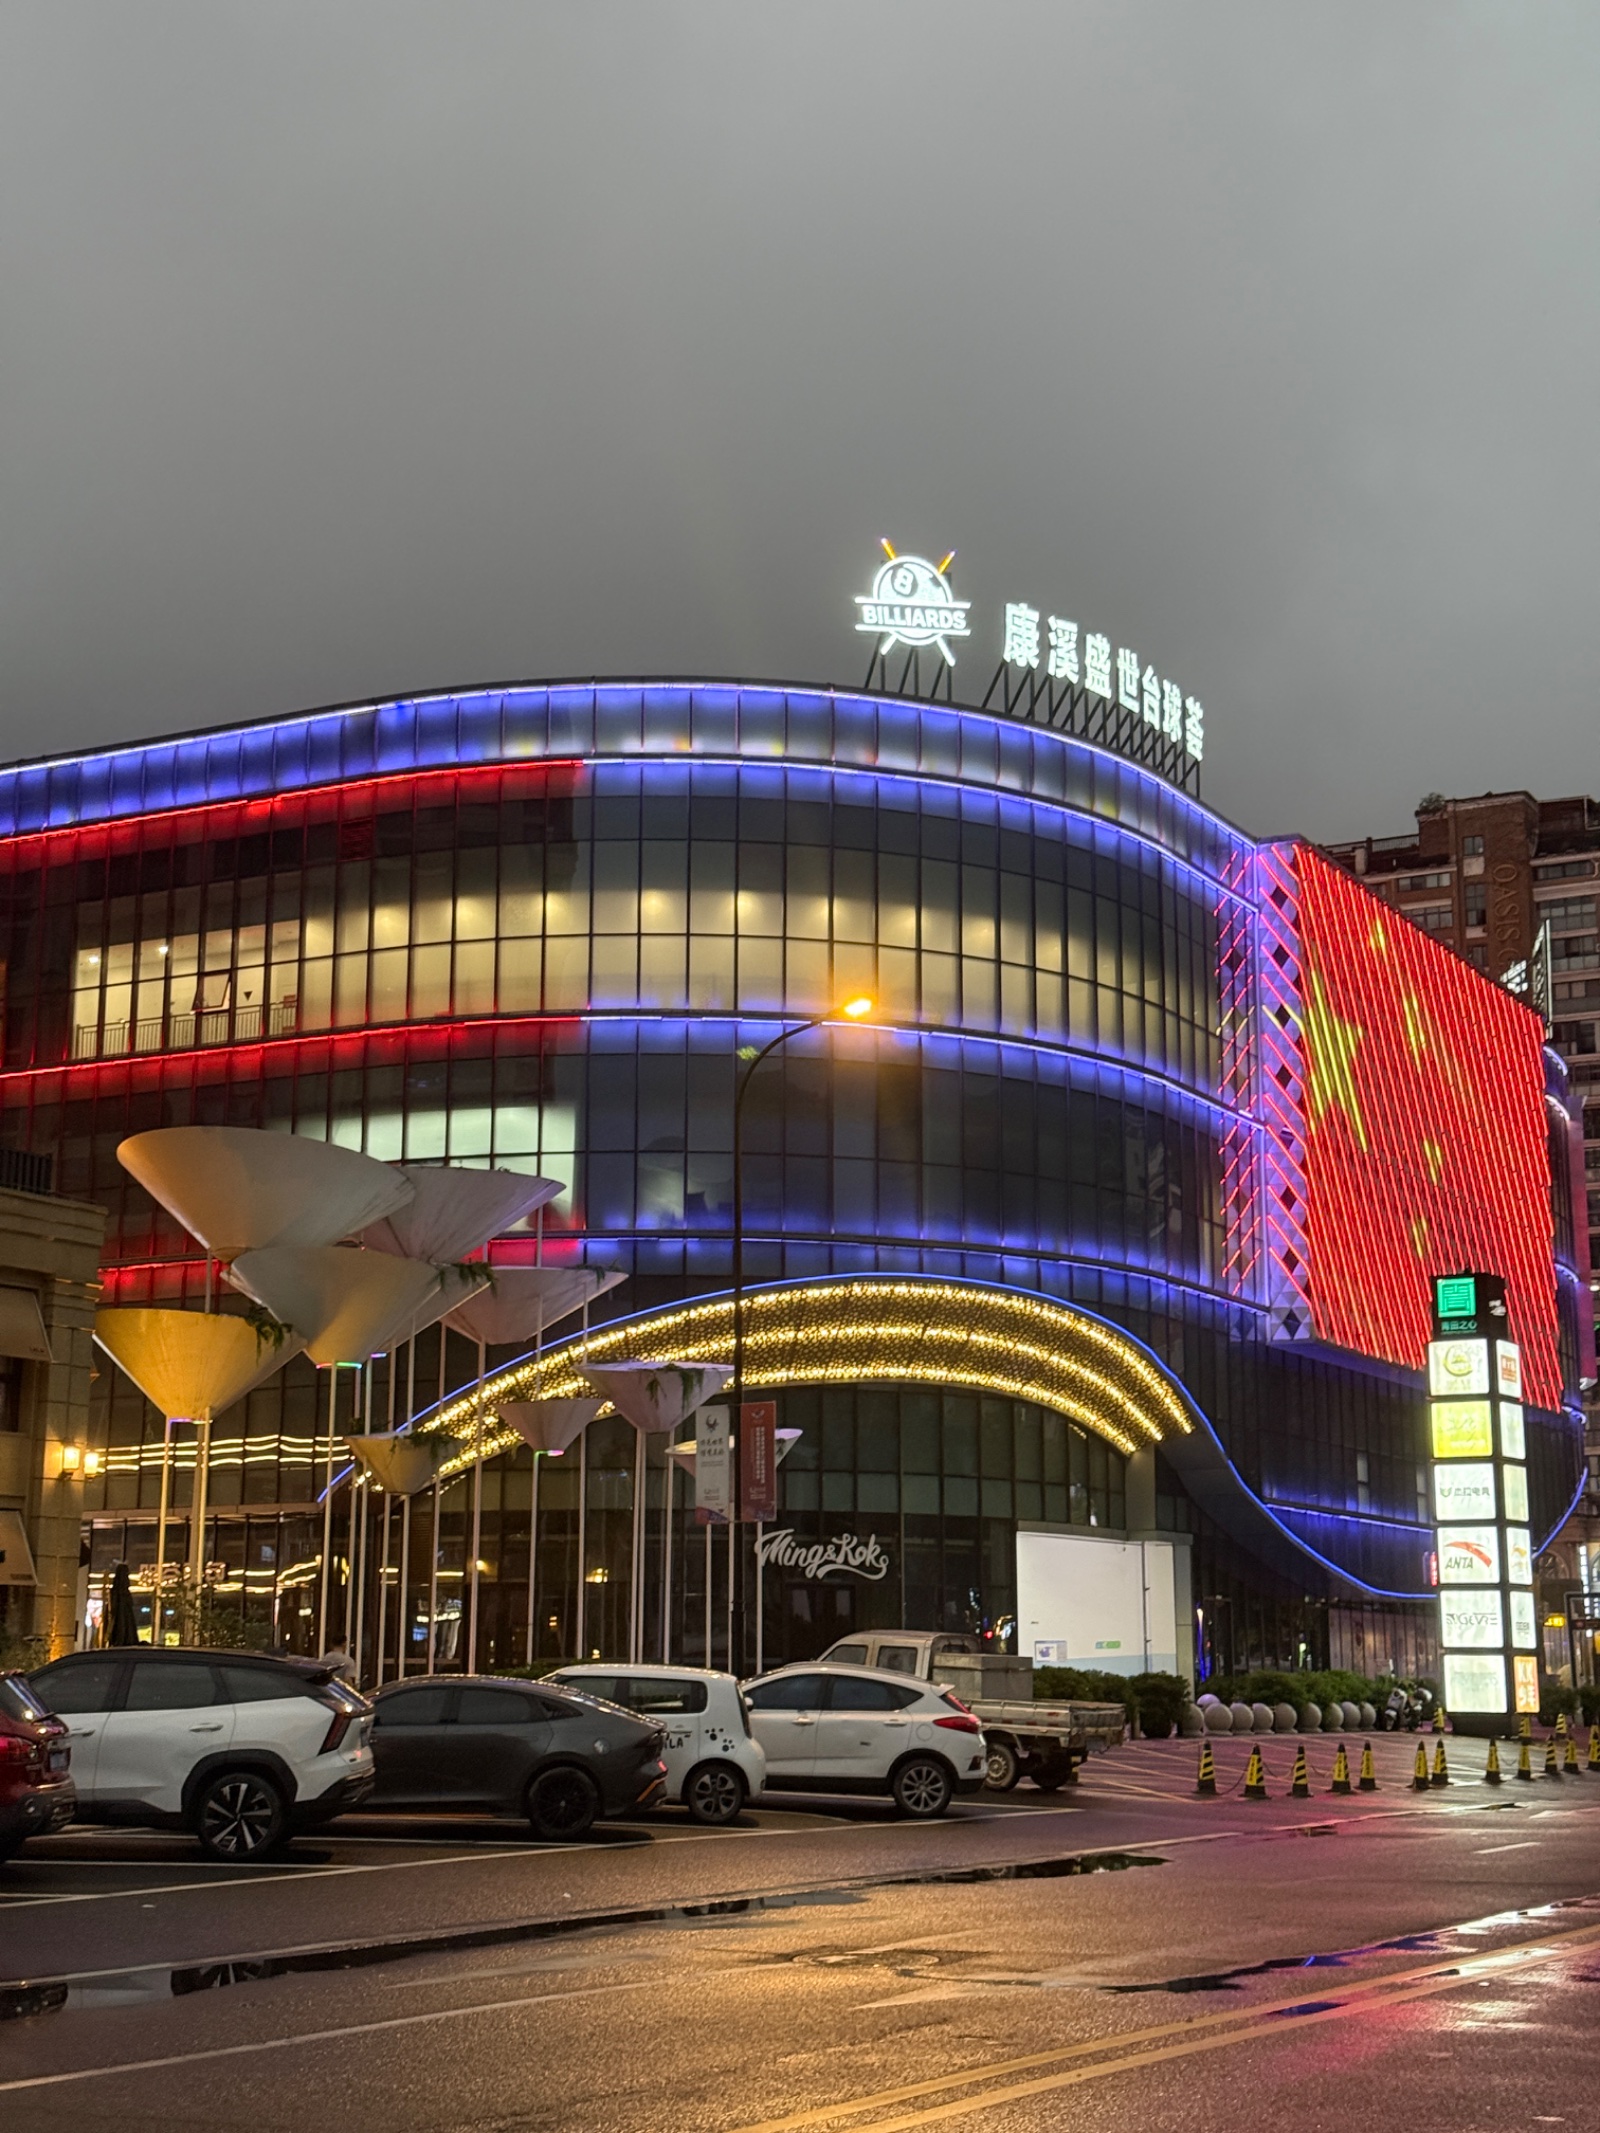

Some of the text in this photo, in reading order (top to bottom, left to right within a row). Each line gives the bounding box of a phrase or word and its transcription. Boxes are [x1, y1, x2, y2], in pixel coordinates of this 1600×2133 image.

[862, 604, 967, 630] BILLIARDS
[1493, 864, 1521, 940] OASIS
[754, 1528, 889, 1581] Ming&Kok
[1444, 1556, 1473, 1570] ANTA
